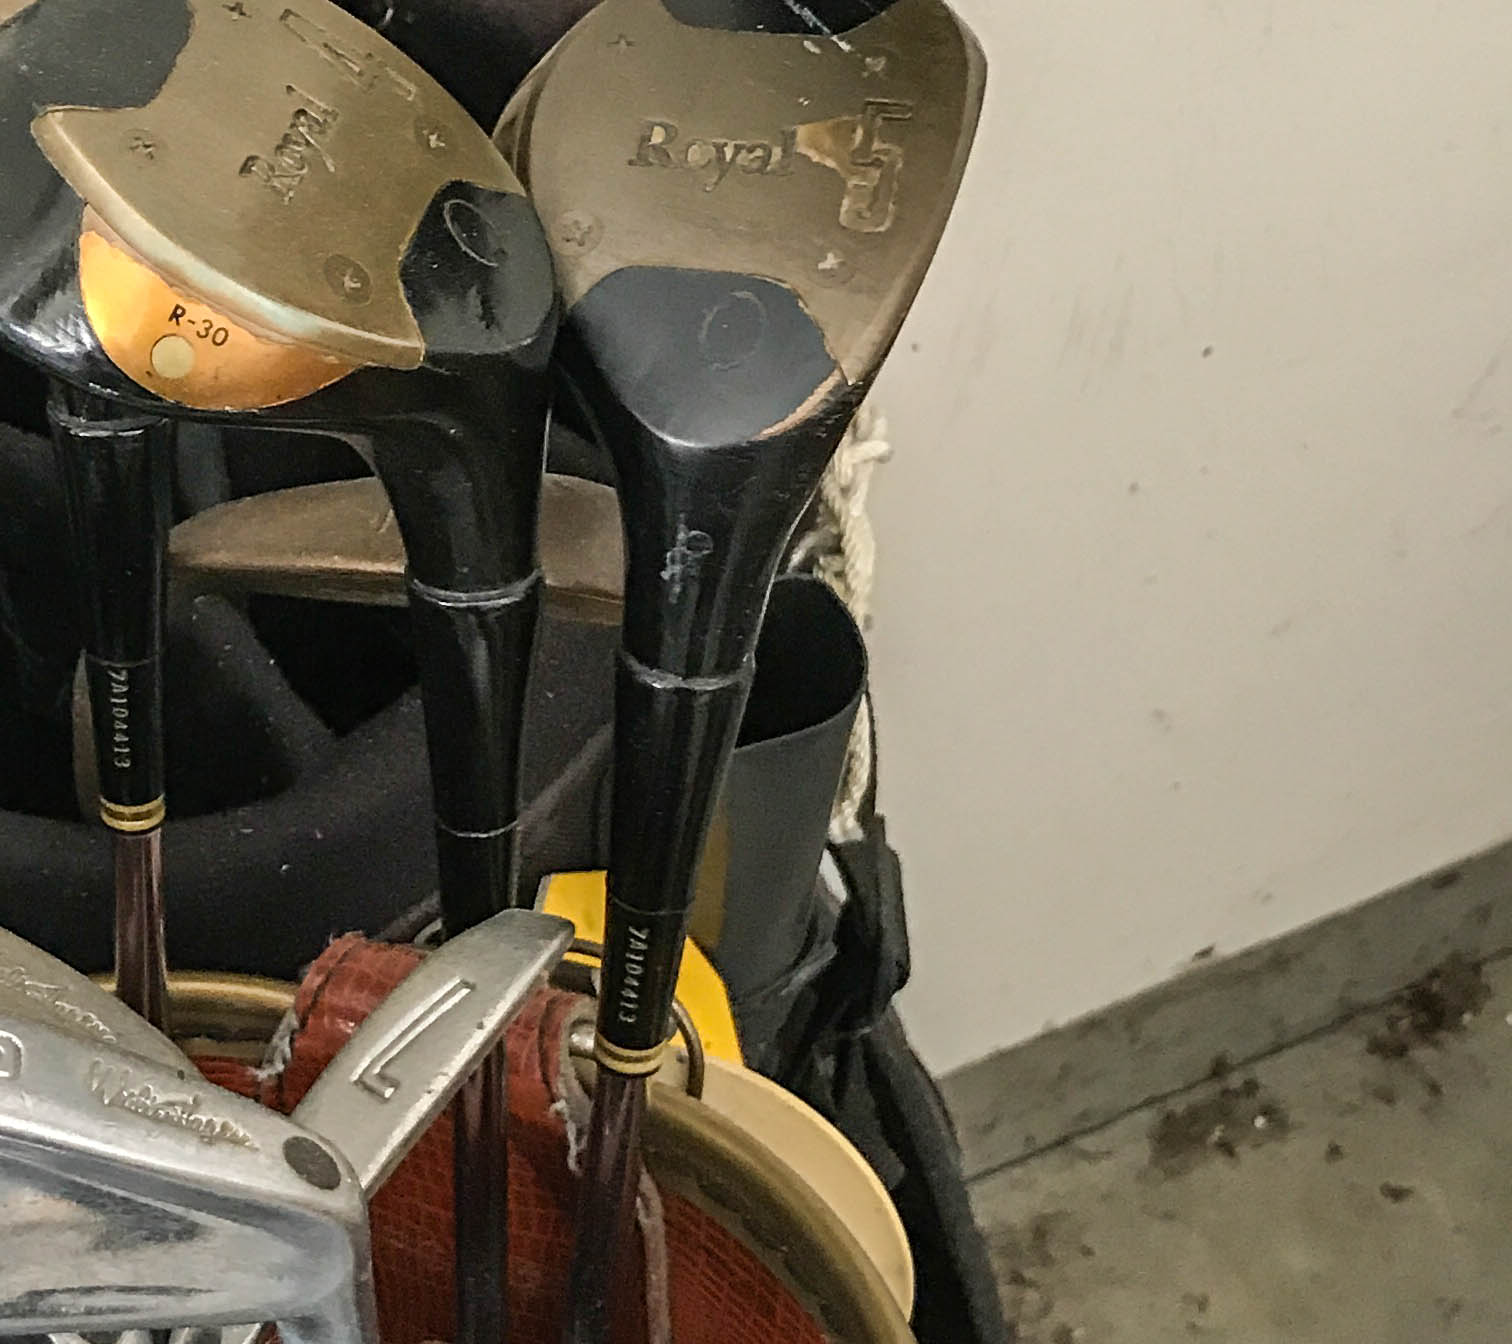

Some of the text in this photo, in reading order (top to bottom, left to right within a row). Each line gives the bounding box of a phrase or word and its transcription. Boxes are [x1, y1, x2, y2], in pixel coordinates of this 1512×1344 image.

[238, 83, 340, 203] Royal
[627, 98, 913, 234] Royal 5
[168, 303, 230, 347] R-30
